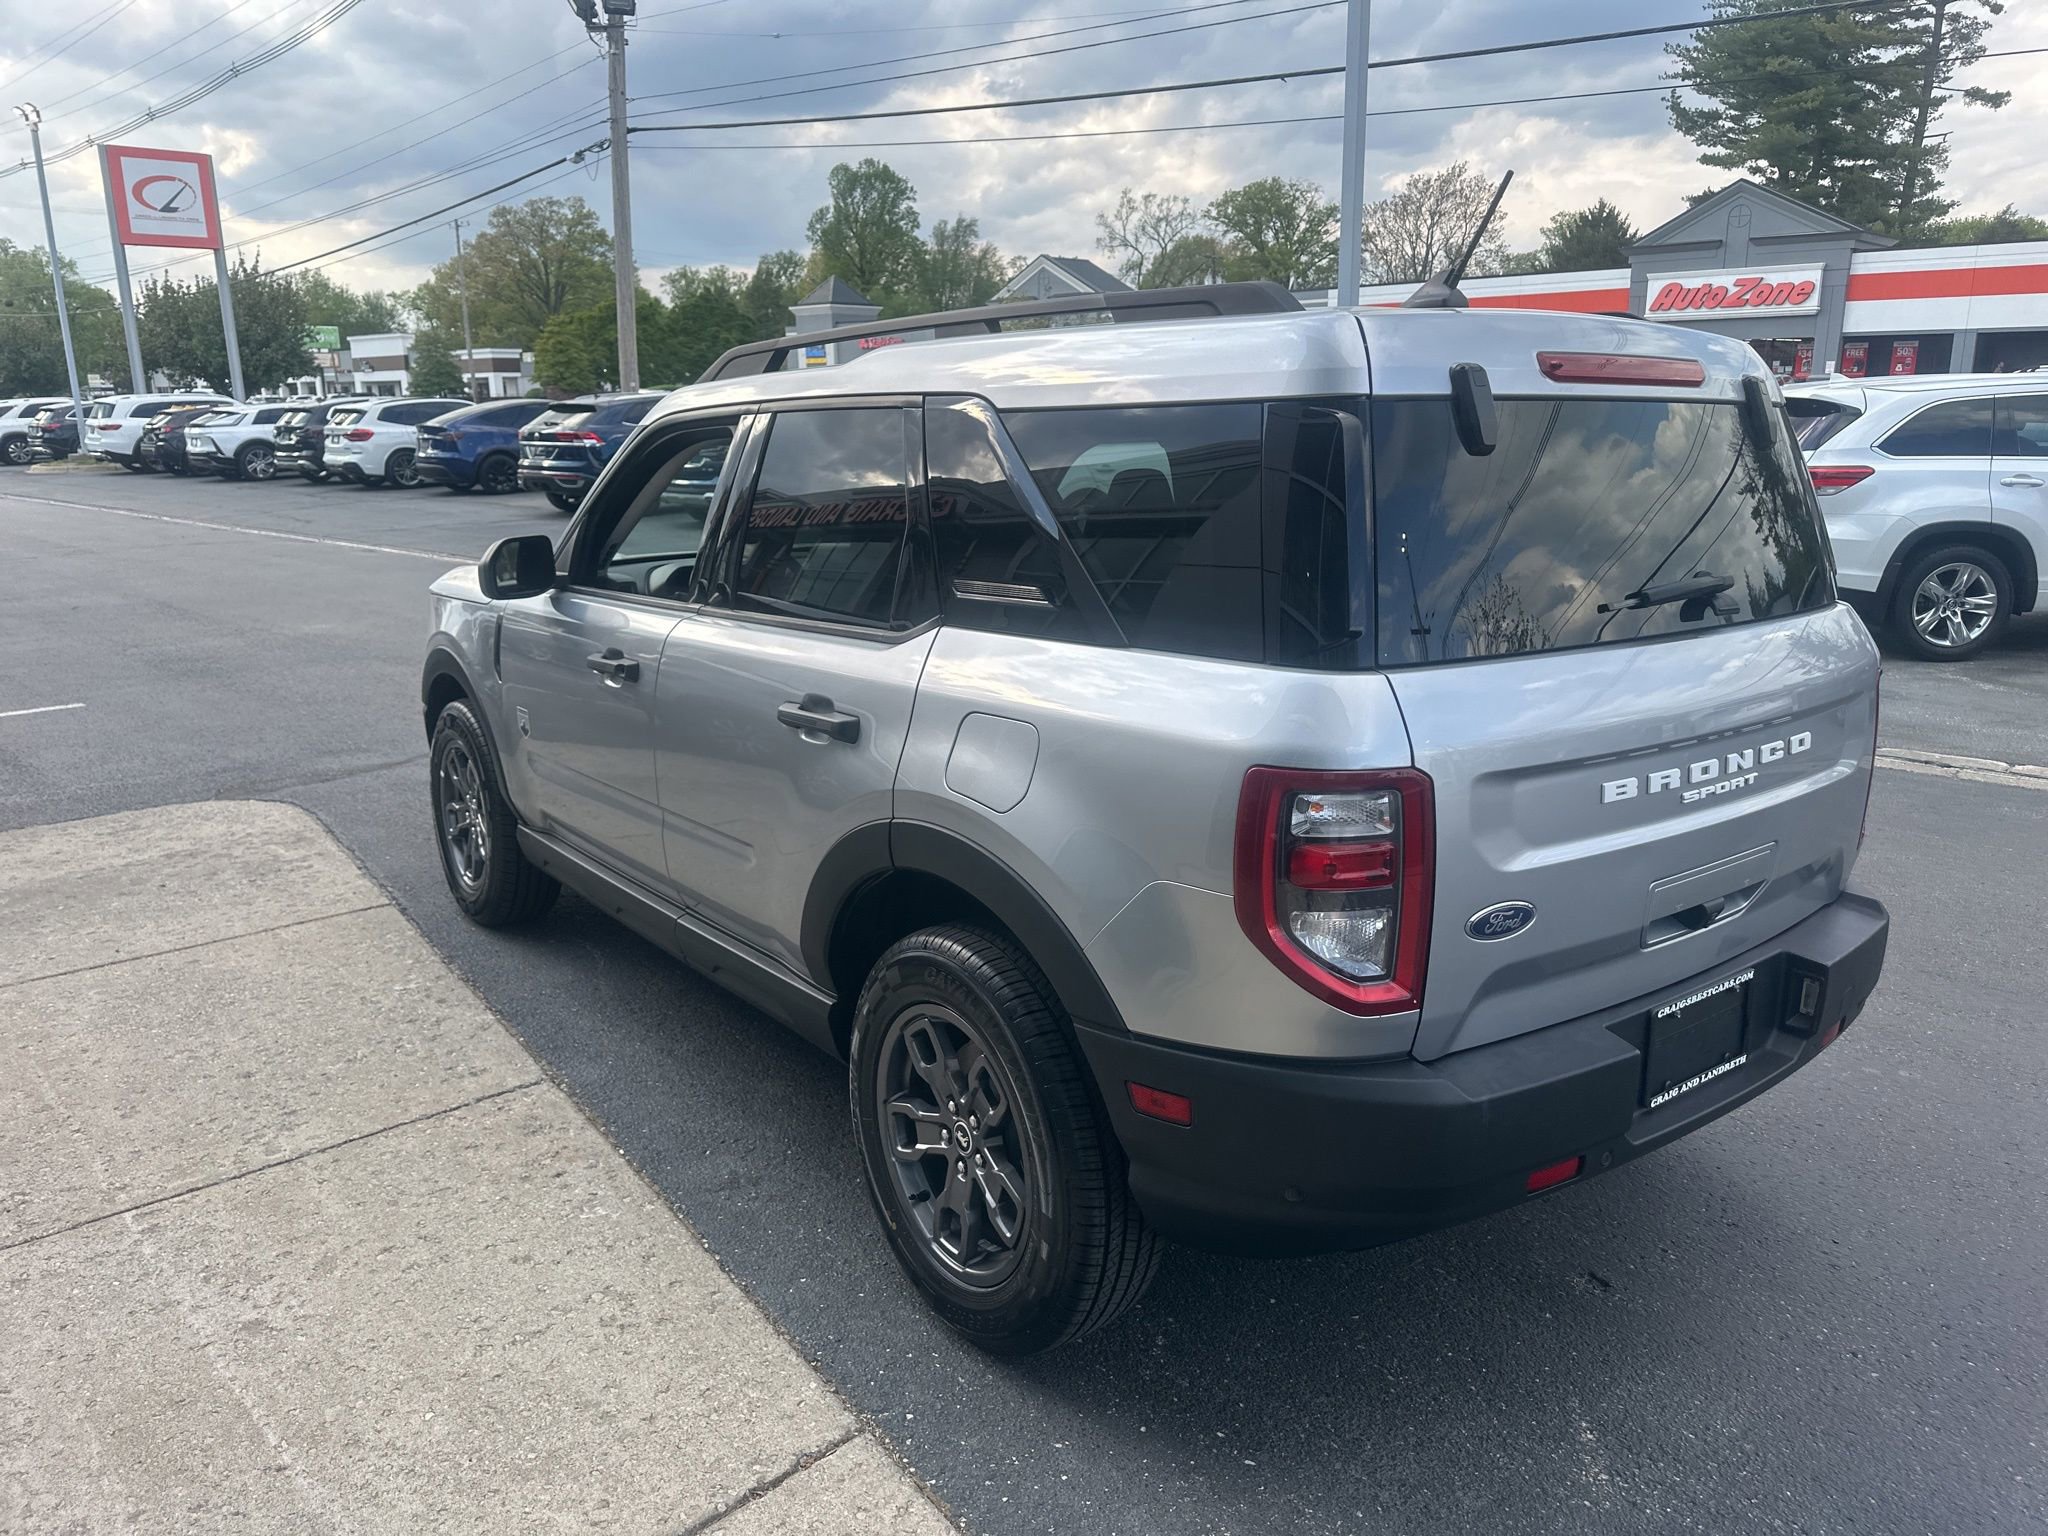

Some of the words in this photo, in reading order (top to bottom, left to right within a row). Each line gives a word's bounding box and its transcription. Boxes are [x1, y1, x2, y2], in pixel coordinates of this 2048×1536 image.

[1649, 277, 1816, 312] AutoZone
[1846, 348, 1865, 358] FREE
[1602, 731, 1811, 803] BRONCO
[1681, 772, 1758, 804] SPORT
[1484, 910, 1523, 934] Ford
[1657, 970, 1754, 1018] CRAIGSBESTCARS.COM
[1650, 1087, 1679, 1108] CRAIG
[1680, 1077, 1700, 1094] AND
[1701, 1054, 1747, 1083] LANDRETH
